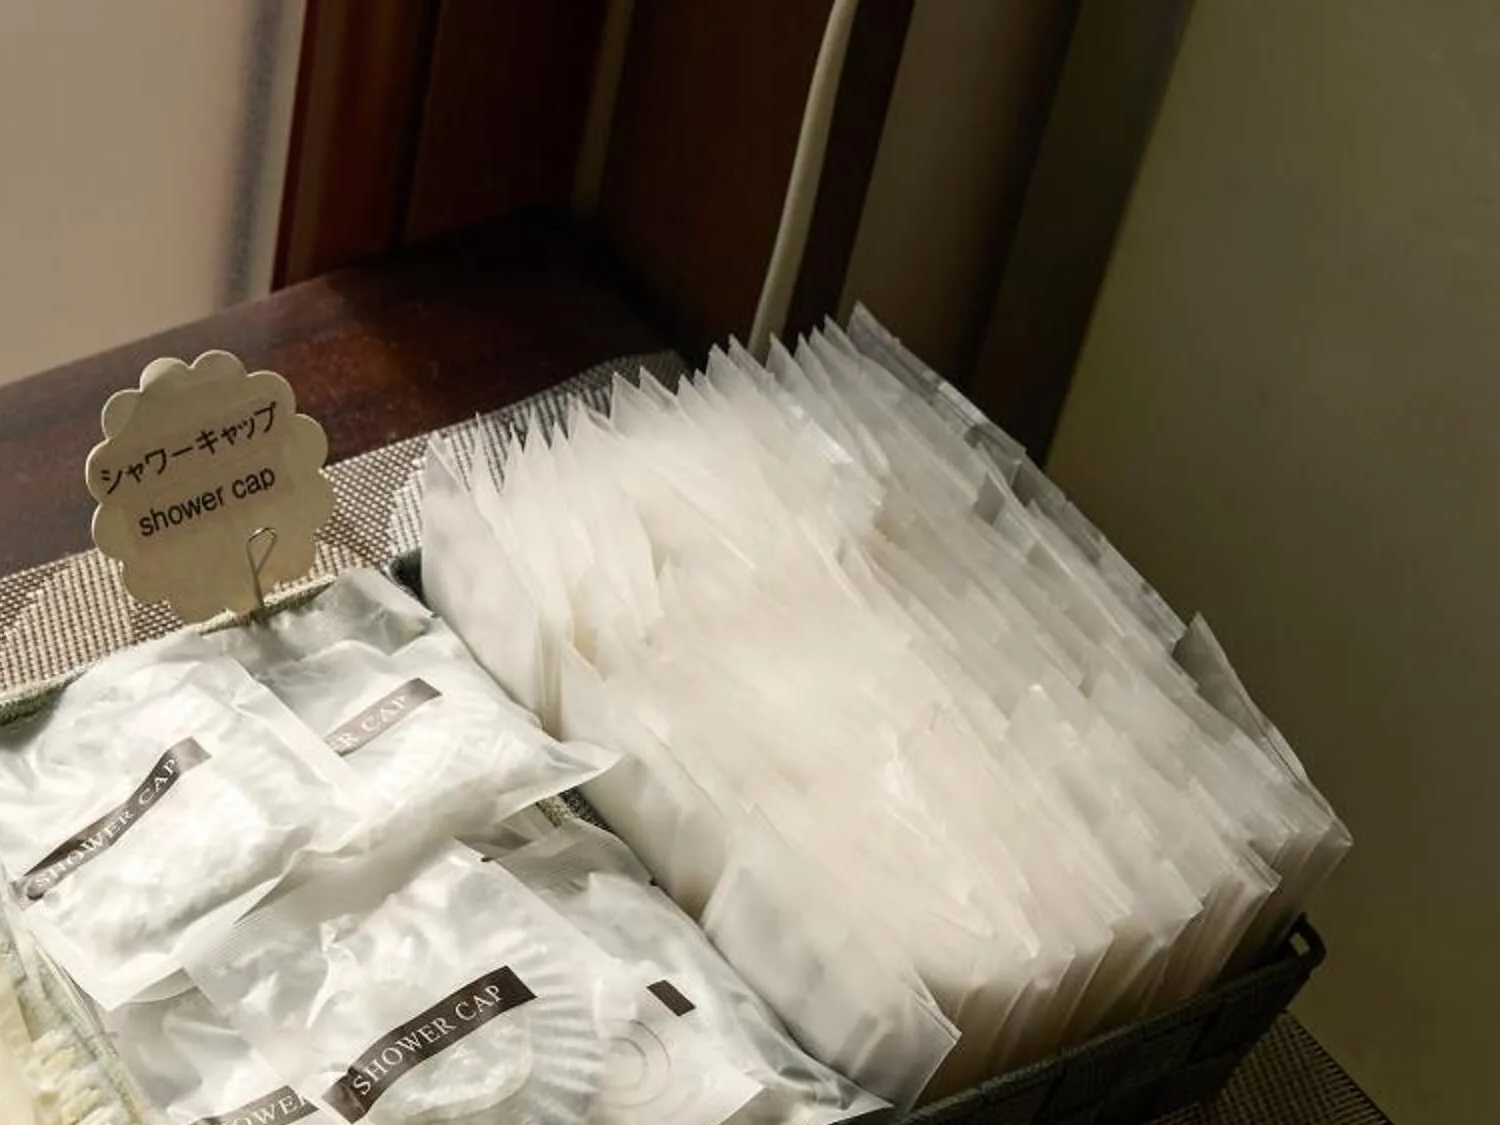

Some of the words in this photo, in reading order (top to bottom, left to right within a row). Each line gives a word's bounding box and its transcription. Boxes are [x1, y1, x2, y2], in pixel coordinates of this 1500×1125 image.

[100, 401, 277, 495] シャワーキャップ
[139, 486, 224, 537] shower
[231, 466, 276, 500] cap
[34, 811, 134, 887] SHOWER
[138, 758, 177, 806] CAP
[353, 1016, 458, 1096] SHOWER
[455, 984, 504, 1021] CAP
